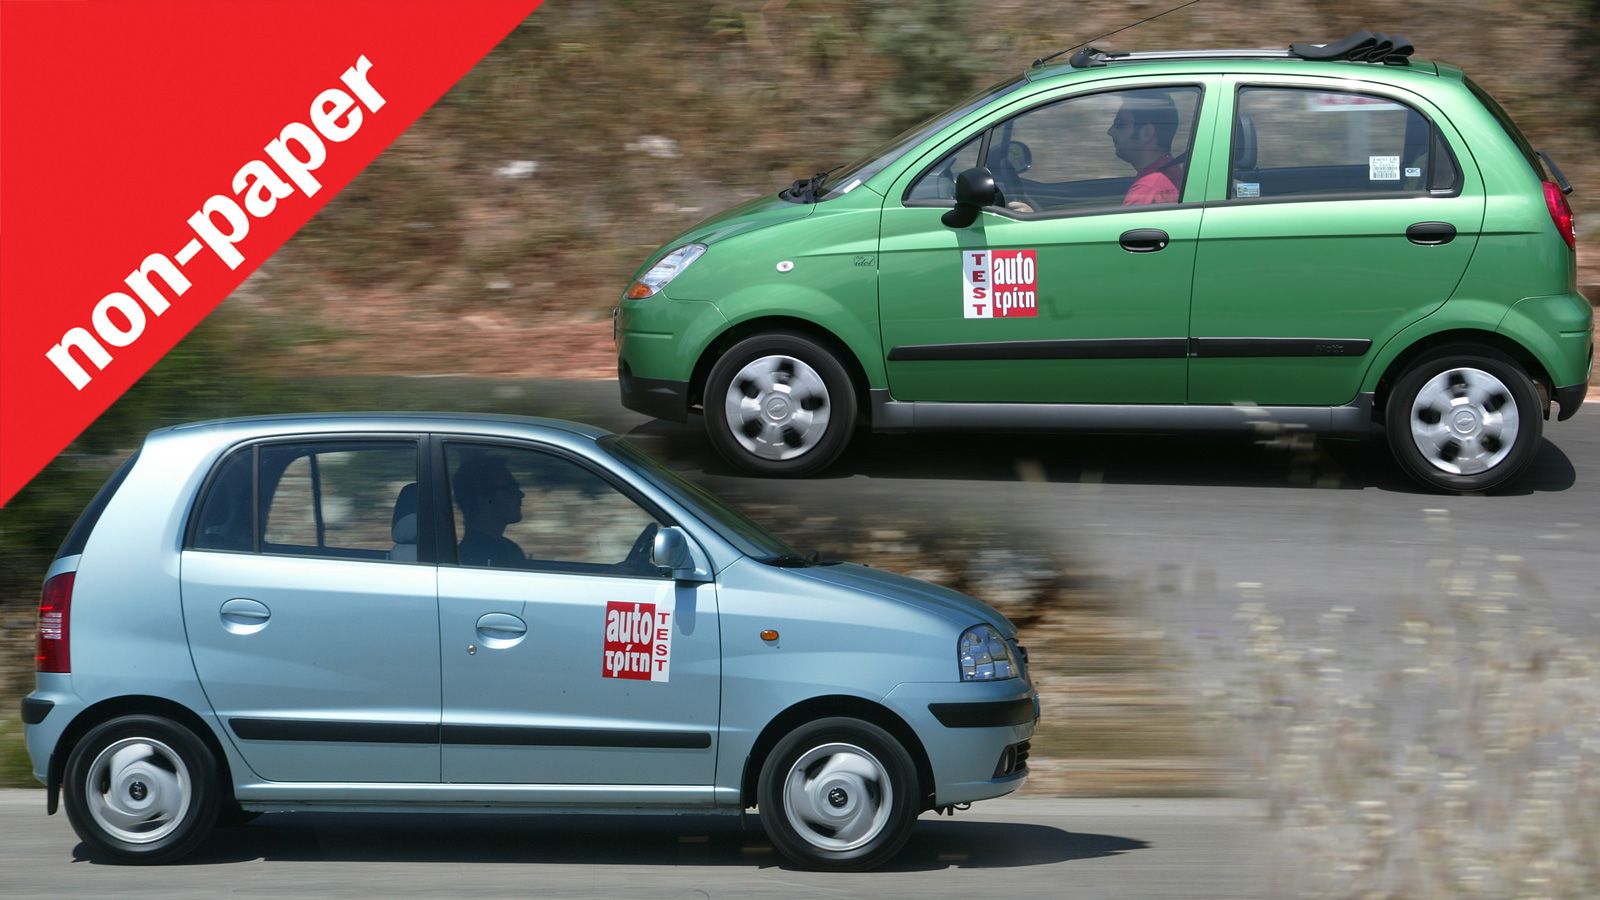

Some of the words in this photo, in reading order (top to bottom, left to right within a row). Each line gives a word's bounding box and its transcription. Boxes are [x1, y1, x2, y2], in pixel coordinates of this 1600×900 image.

[971, 253, 987, 316] TEST
[993, 251, 1035, 285] auto
[606, 603, 653, 645] auto
[654, 612, 671, 671] TEST
